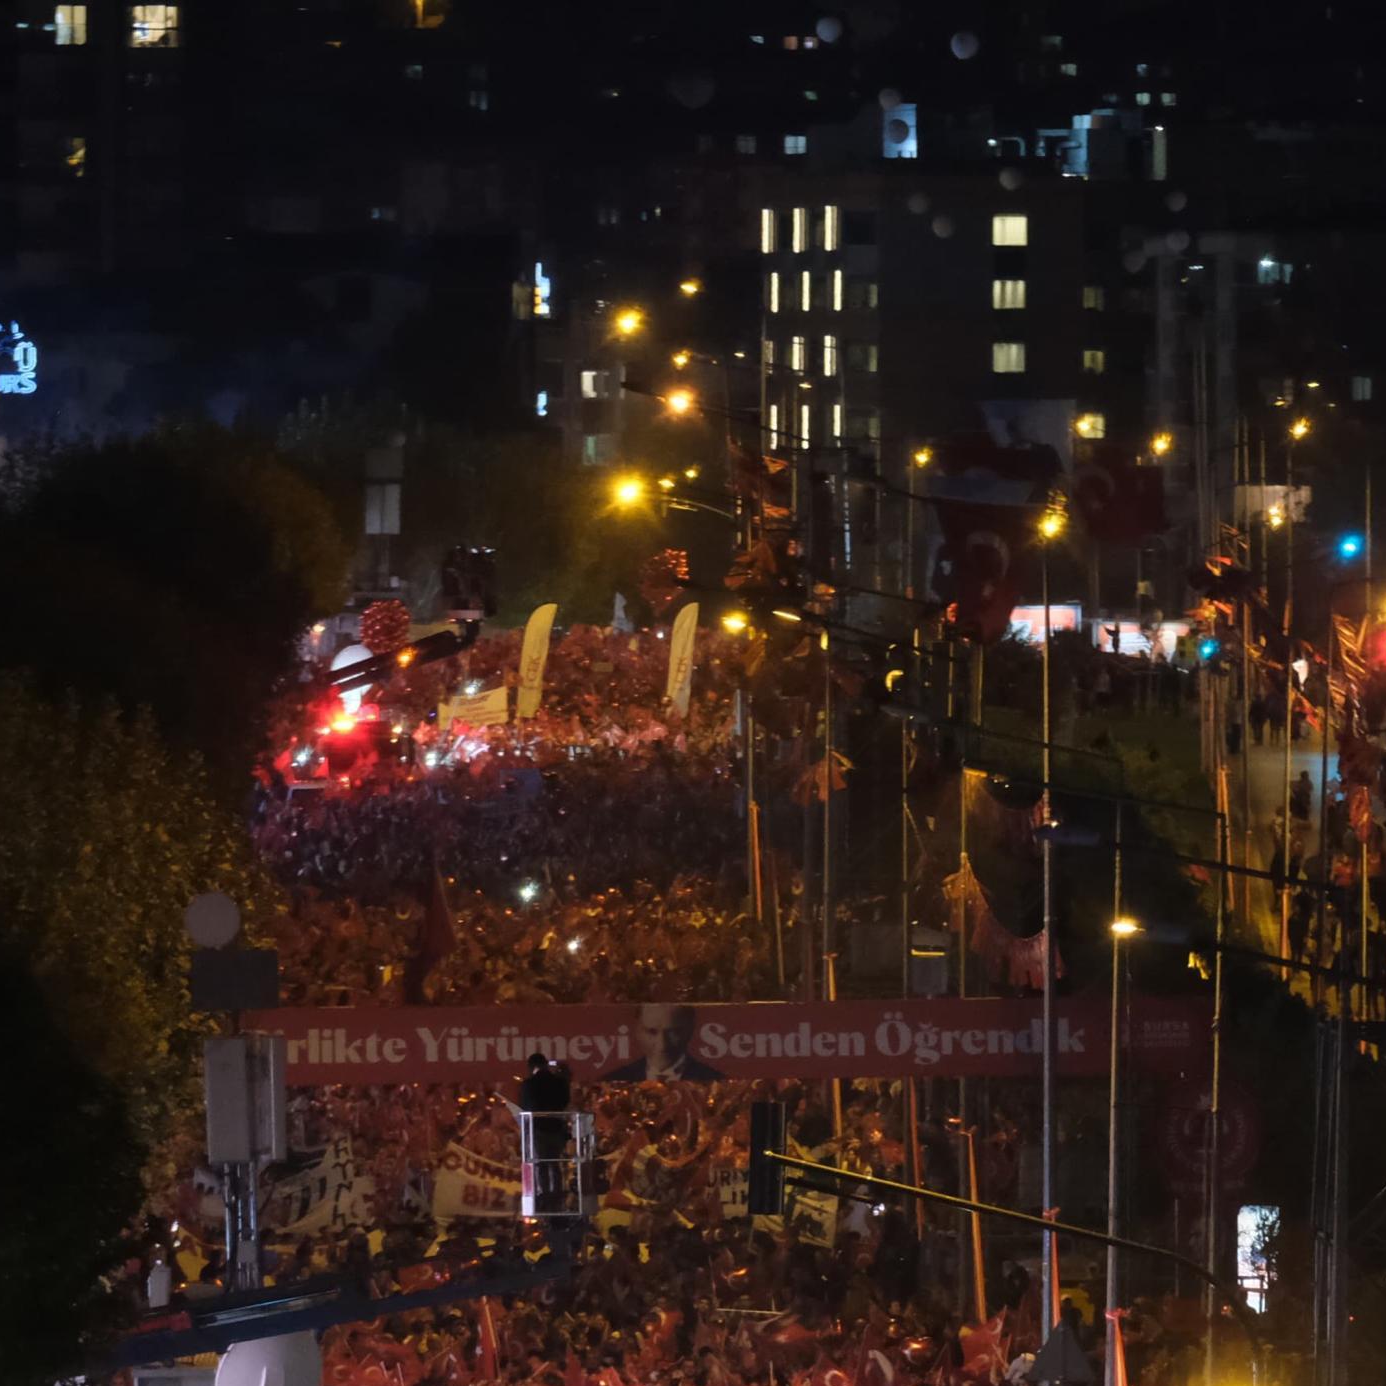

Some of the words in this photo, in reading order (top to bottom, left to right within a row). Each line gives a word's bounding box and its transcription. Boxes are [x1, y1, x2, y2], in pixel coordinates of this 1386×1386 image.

[286, 1028, 408, 1064] rlikte
[416, 1025, 630, 1069] Yürümeyi
[699, 1022, 865, 1059] Senden
[874, 1011, 1086, 1065] Öğrendk
